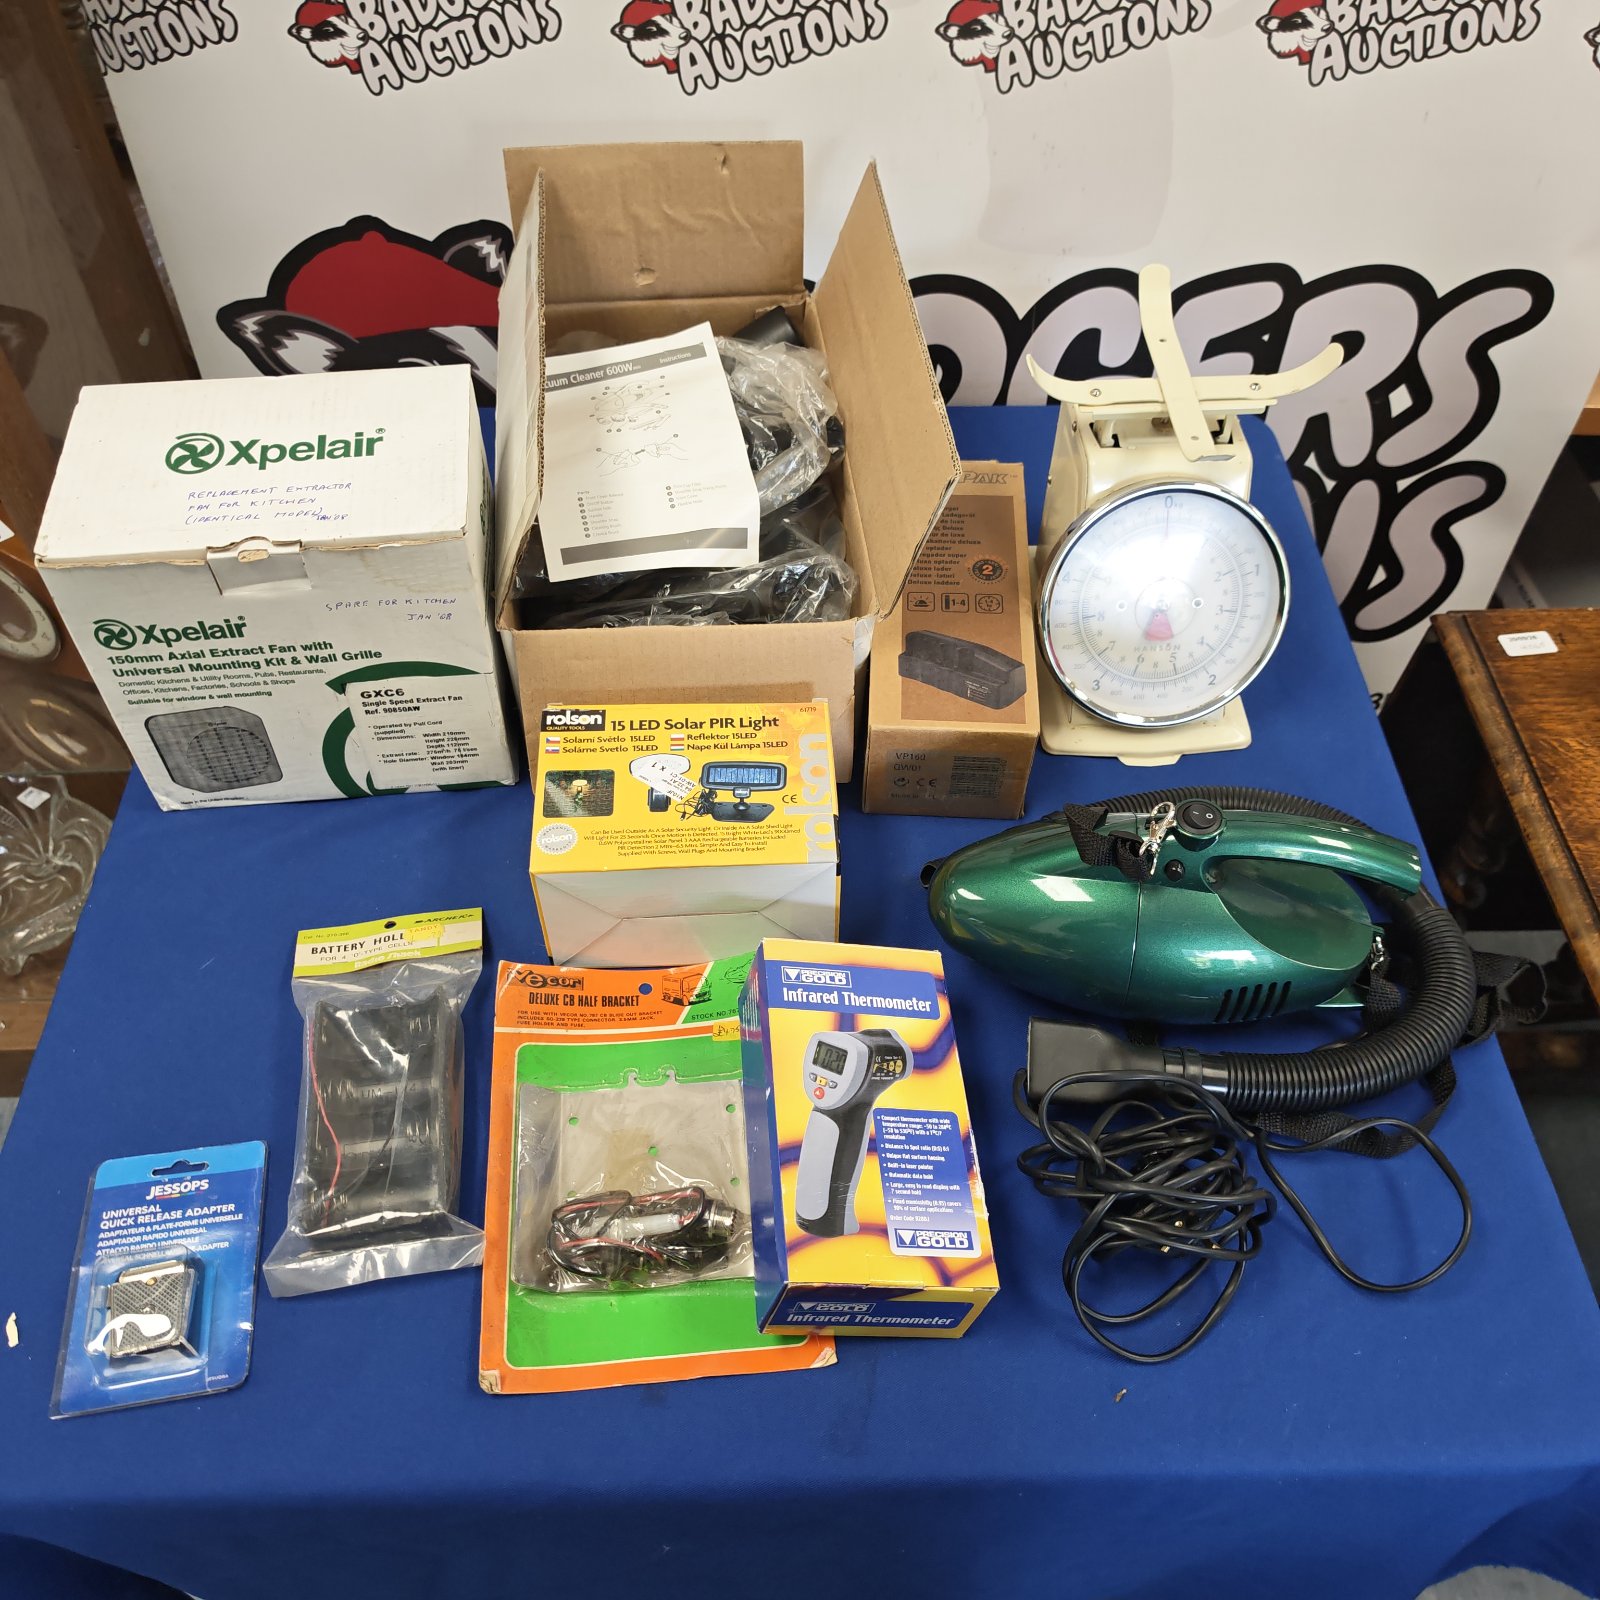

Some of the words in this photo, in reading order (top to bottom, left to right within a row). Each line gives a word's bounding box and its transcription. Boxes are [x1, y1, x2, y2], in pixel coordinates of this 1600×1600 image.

[88, 0, 239, 76] UCTIONS
[1308, 0, 1542, 87] AUCTIONS
[358, 0, 562, 96] AUCTIONS
[677, 0, 889, 96] AUCTIONS
[995, 0, 1212, 94] AUCTIONS
[659, 351, 692, 364] Instructions
[545, 376, 569, 390] cuum
[570, 370, 605, 384] Cleaner
[606, 362, 634, 375] 600W
[187, 486, 278, 500] REPLACEMENT
[218, 500, 240, 509] FOR
[250, 497, 317, 507] KITCHEN
[1164, 495, 1174, 509] 0
[325, 599, 369, 612] SPARE
[405, 597, 457, 605] KITCHEN
[951, 598, 967, 607] 1-4
[408, 613, 432, 621] JAN
[107, 654, 164, 666] 150mm
[168, 650, 206, 661] Axial
[210, 646, 266, 658] Extract
[267, 644, 297, 654] Fan
[300, 640, 334, 651] with
[112, 663, 185, 678] Universal
[190, 658, 261, 673] Mounting
[265, 656, 288, 667] Kit
[290, 656, 302, 666] &
[304, 653, 338, 665] Wall
[341, 650, 383, 662] Grille
[118, 678, 156, 688] Domestic
[157, 676, 191, 686] Kitchens
[200, 673, 222, 683] Utility
[223, 672, 253, 681] Rooms,
[278, 667, 327, 677] Restaurants,
[1208, 674, 1216, 686] 2
[122, 688, 153, 697] Offices,
[154, 685, 190, 695] Kitchens,
[191, 682, 228, 692] Factories,
[230, 680, 262, 689] Schools
[271, 678, 296, 687] Shops
[1091, 679, 1101, 691] 3
[127, 696, 162, 706] Suitable
[162, 696, 174, 704] for
[175, 693, 207, 703] window
[216, 691, 233, 699] wall
[234, 690, 273, 699] mounting
[360, 688, 405, 699] GXC6
[361, 700, 387, 708] Single
[389, 698, 414, 706] Speed
[416, 695, 446, 704] Extract
[546, 711, 603, 727] rolson
[610, 720, 626, 732] 15
[630, 718, 660, 731] LED
[664, 717, 707, 730] Solar
[710, 716, 736, 729] PIR
[739, 715, 780, 731] Light
[630, 734, 656, 743] 15LED
[687, 732, 730, 741] Reflektor
[732, 732, 758, 740] 15LED
[599, 744, 629, 753] Svetlo
[633, 744, 659, 752] 15LED
[687, 742, 711, 752] Nape
[713, 740, 729, 750] Kül
[730, 740, 761, 752] Lámpa
[762, 740, 788, 749] 15LED
[311, 941, 366, 955] BATTERY
[801, 969, 846, 978] PRECISION
[801, 974, 847, 985] GOLD
[528, 992, 560, 1006] DELUXE
[563, 993, 575, 1006] CB
[577, 995, 598, 1008] HALF
[601, 994, 640, 1008] BRACKET
[782, 987, 839, 1005] Infrared
[841, 991, 932, 1013] Thermometer
[691, 1013, 715, 1021] STOCK
[145, 1179, 210, 1200] JESSOPS
[100, 1217, 135, 1230] QUICK
[137, 1210, 183, 1224] RELEASE
[185, 1203, 236, 1218] ADAPTER
[102, 1204, 162, 1220] UNIVERSAL
[96, 1236, 142, 1248] ADAPTADOR
[142, 1231, 169, 1242] RAPIDO
[169, 1226, 208, 1238] UNIVERSAL
[98, 1227, 145, 1239] ADAPTATEUR
[916, 1230, 968, 1239] PRECISION
[917, 1235, 969, 1249] GOLD
[786, 1314, 850, 1323] Infrared
[854, 1314, 955, 1326] Thermometer
